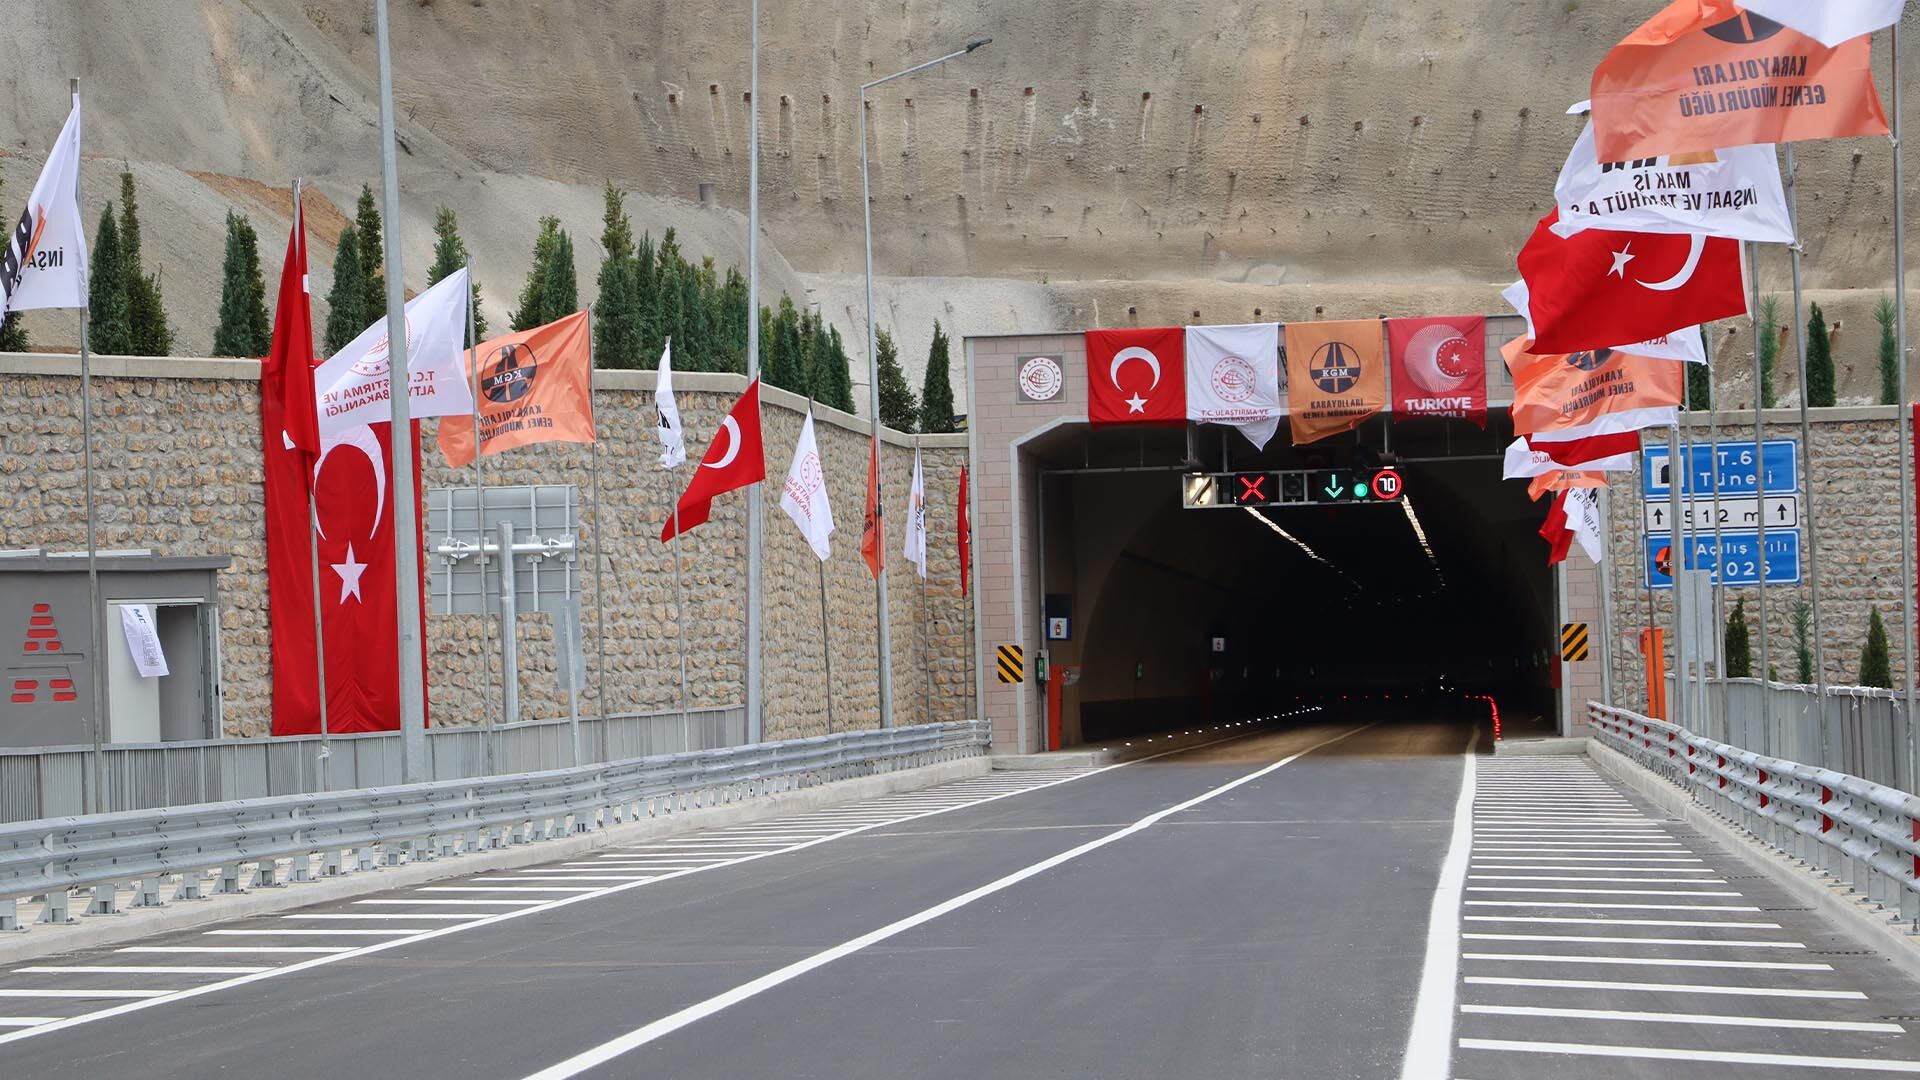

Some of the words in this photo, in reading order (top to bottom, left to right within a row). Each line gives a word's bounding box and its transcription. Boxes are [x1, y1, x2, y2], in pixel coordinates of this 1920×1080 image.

[1322, 368, 1348, 377] KGM
[1379, 477, 1396, 492] 70
[1699, 470, 1773, 487] Tünei
[1685, 509, 1729, 523] 512
[1744, 511, 1760, 521] m
[1696, 542, 1748, 555] Açılış
[1756, 540, 1787, 553] ılı
